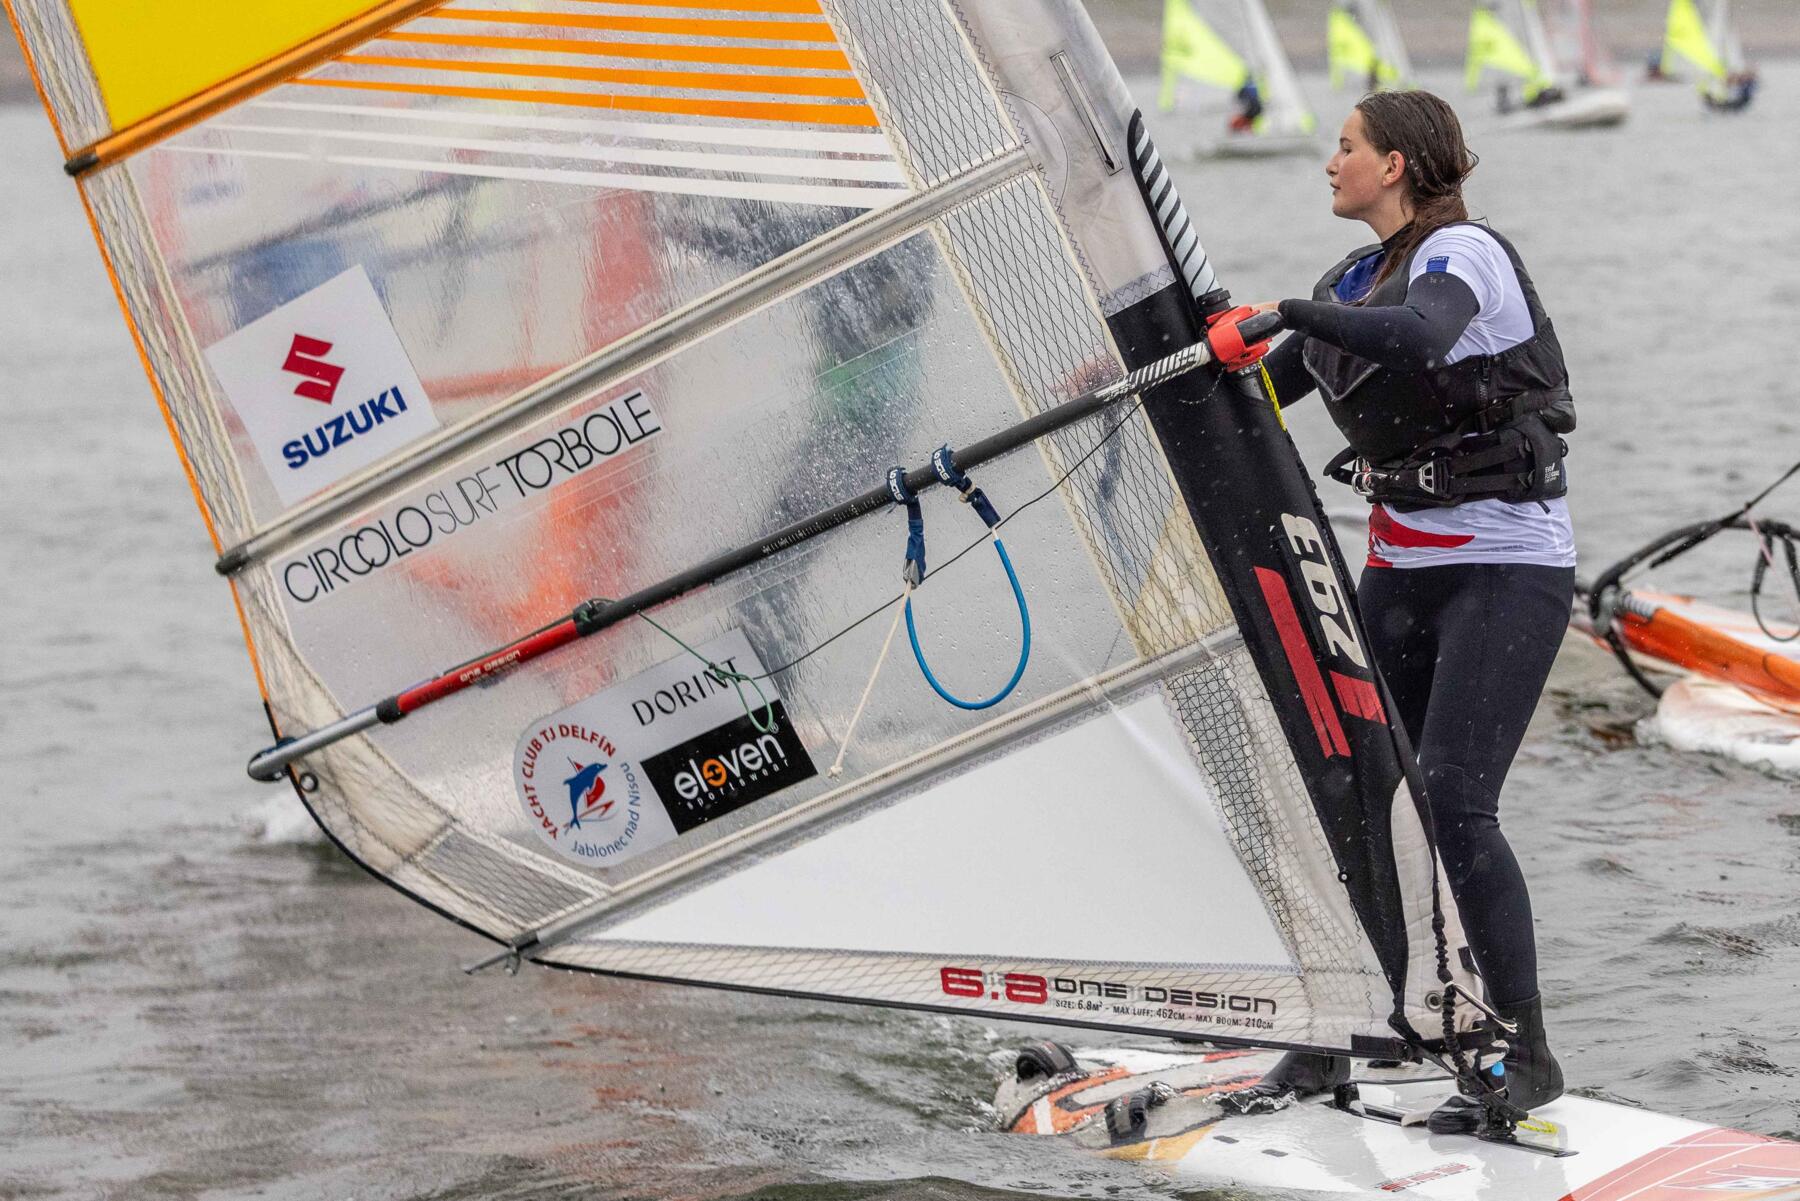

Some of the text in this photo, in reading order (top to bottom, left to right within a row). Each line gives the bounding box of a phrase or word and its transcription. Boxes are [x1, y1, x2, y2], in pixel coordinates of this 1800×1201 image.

[282, 385, 408, 469] SUZUKI
[284, 392, 661, 603] CIRCOLO SURF TORBOLE
[1281, 513, 1369, 669] 293
[631, 656, 736, 726] DORINT
[522, 723, 616, 840] YACHT CLUB TJ DELFÍN
[674, 734, 786, 800] eleven
[570, 762, 641, 858] Jablonec nad Nisou
[940, 967, 1277, 1015] 6.8 ONE DESIGN
[1055, 999, 1075, 1009] SIZE:
[1113, 1005, 1130, 1015] MAX
[1132, 1007, 1154, 1017] LUFF:
[1156, 1008, 1185, 1020] 462CM
[1195, 1014, 1213, 1024] MAX
[1216, 1016, 1242, 1026] BOOM:
[1245, 1017, 1274, 1030] 210CM
